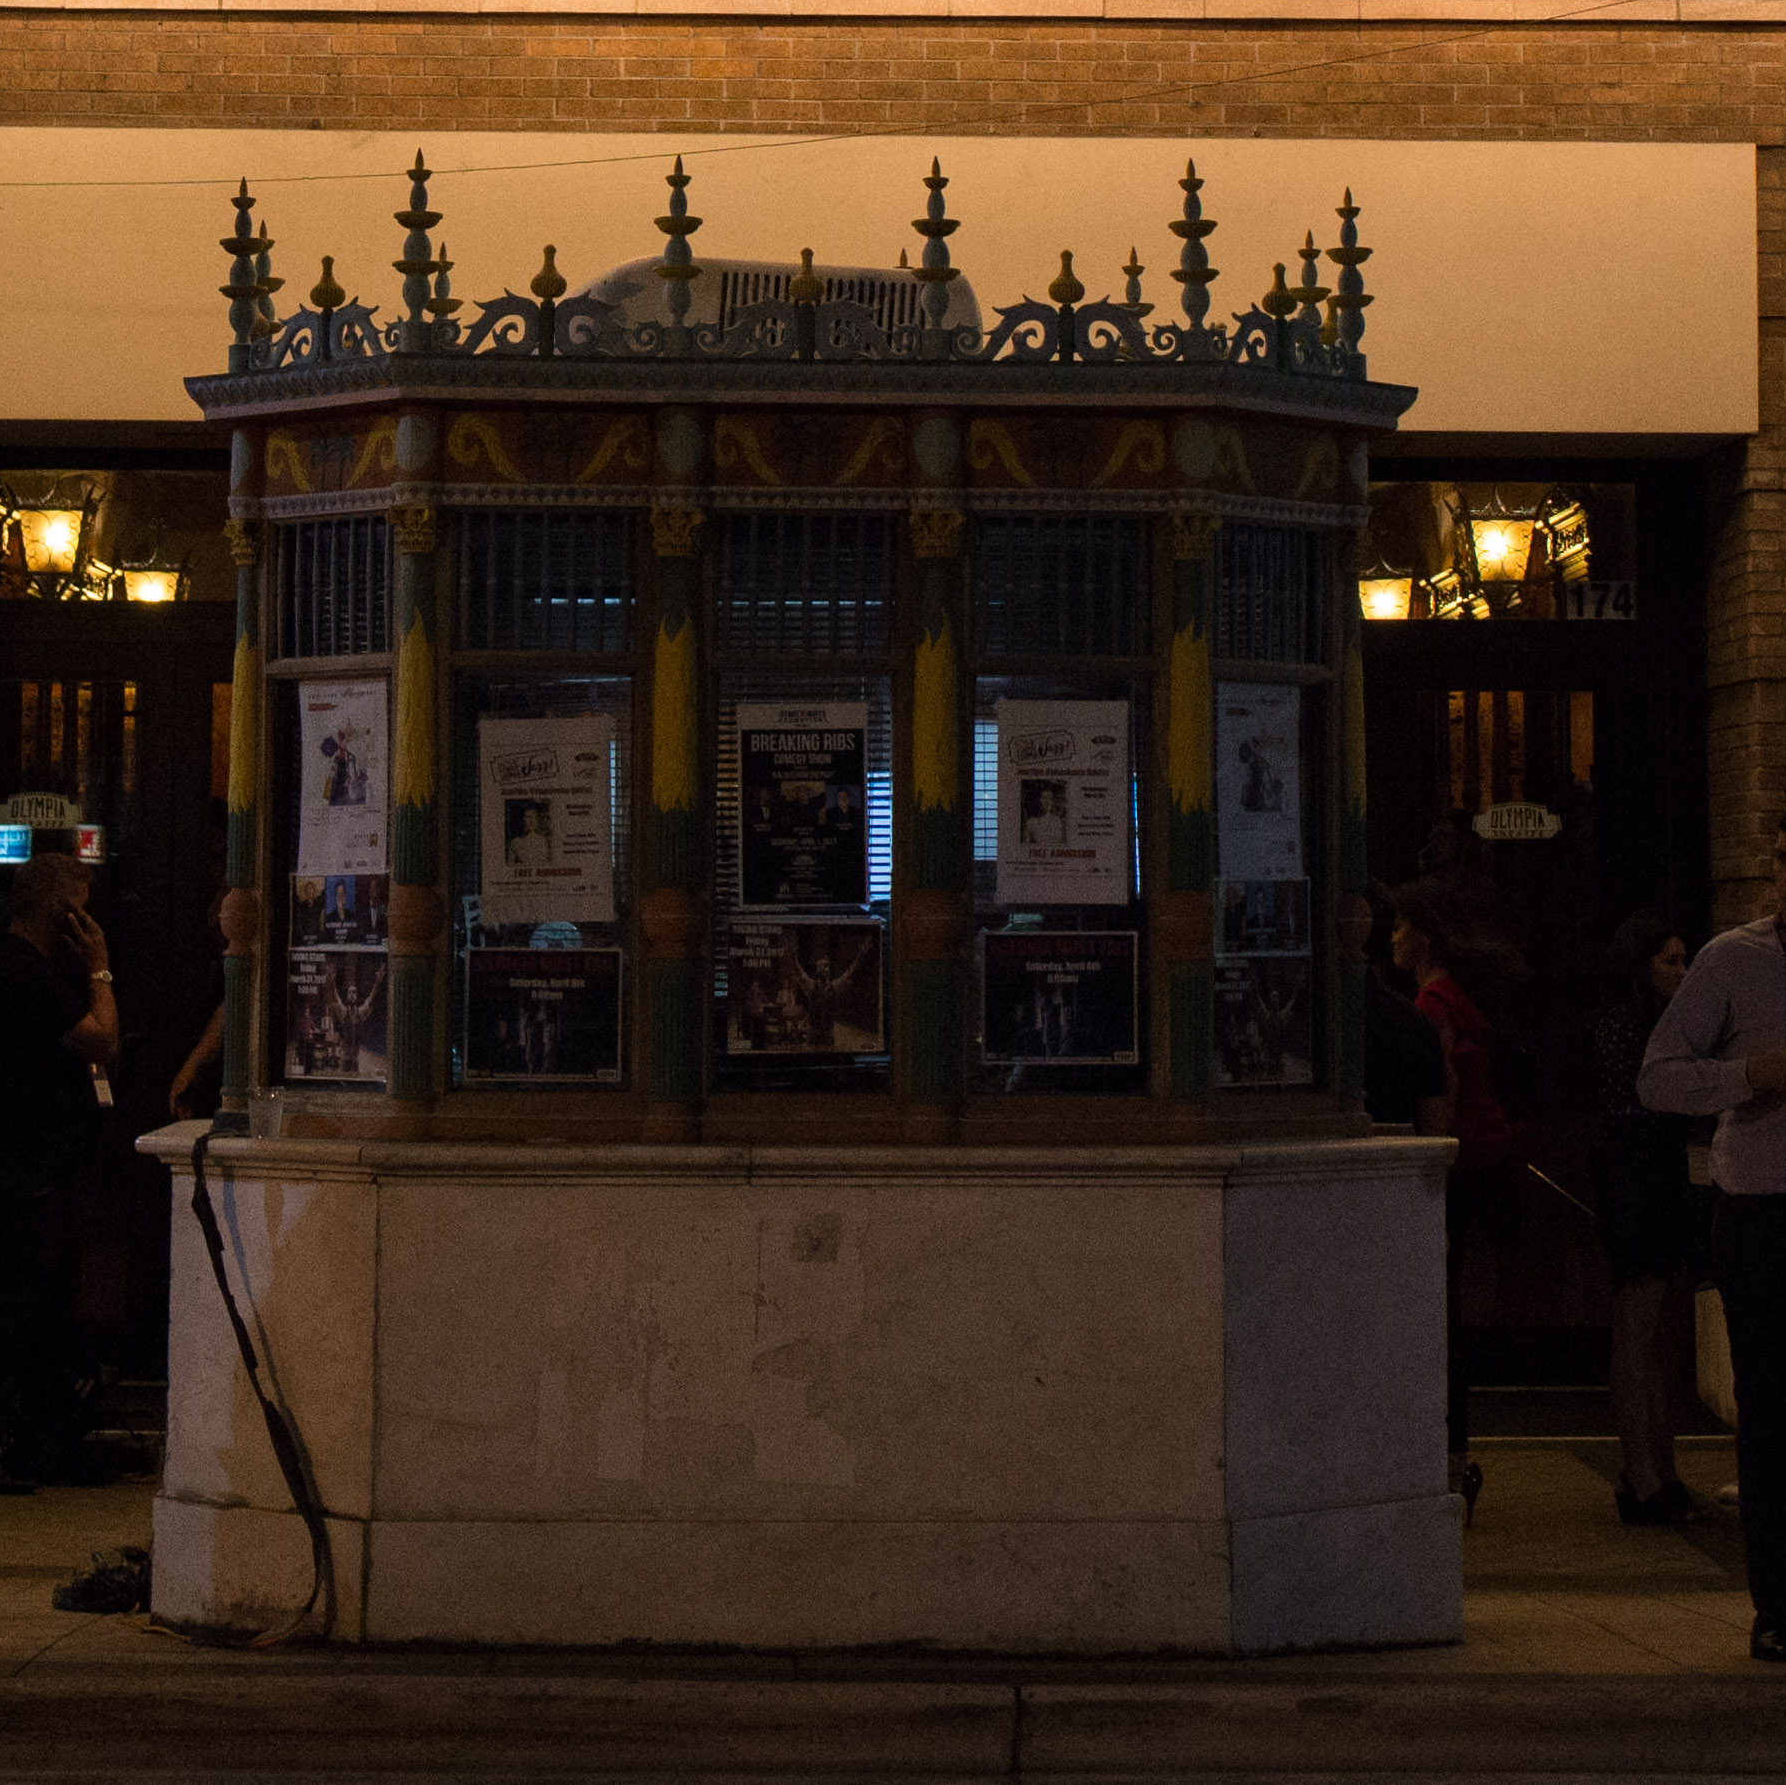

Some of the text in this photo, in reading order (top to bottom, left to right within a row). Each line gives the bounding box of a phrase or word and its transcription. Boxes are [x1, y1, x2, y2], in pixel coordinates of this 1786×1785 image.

[1571, 584, 1634, 618] 174
[750, 733, 856, 752] BREAKING RIBS
[11, 797, 66, 819] OLYMPIA
[1490, 807, 1545, 828] OLYMPIA
